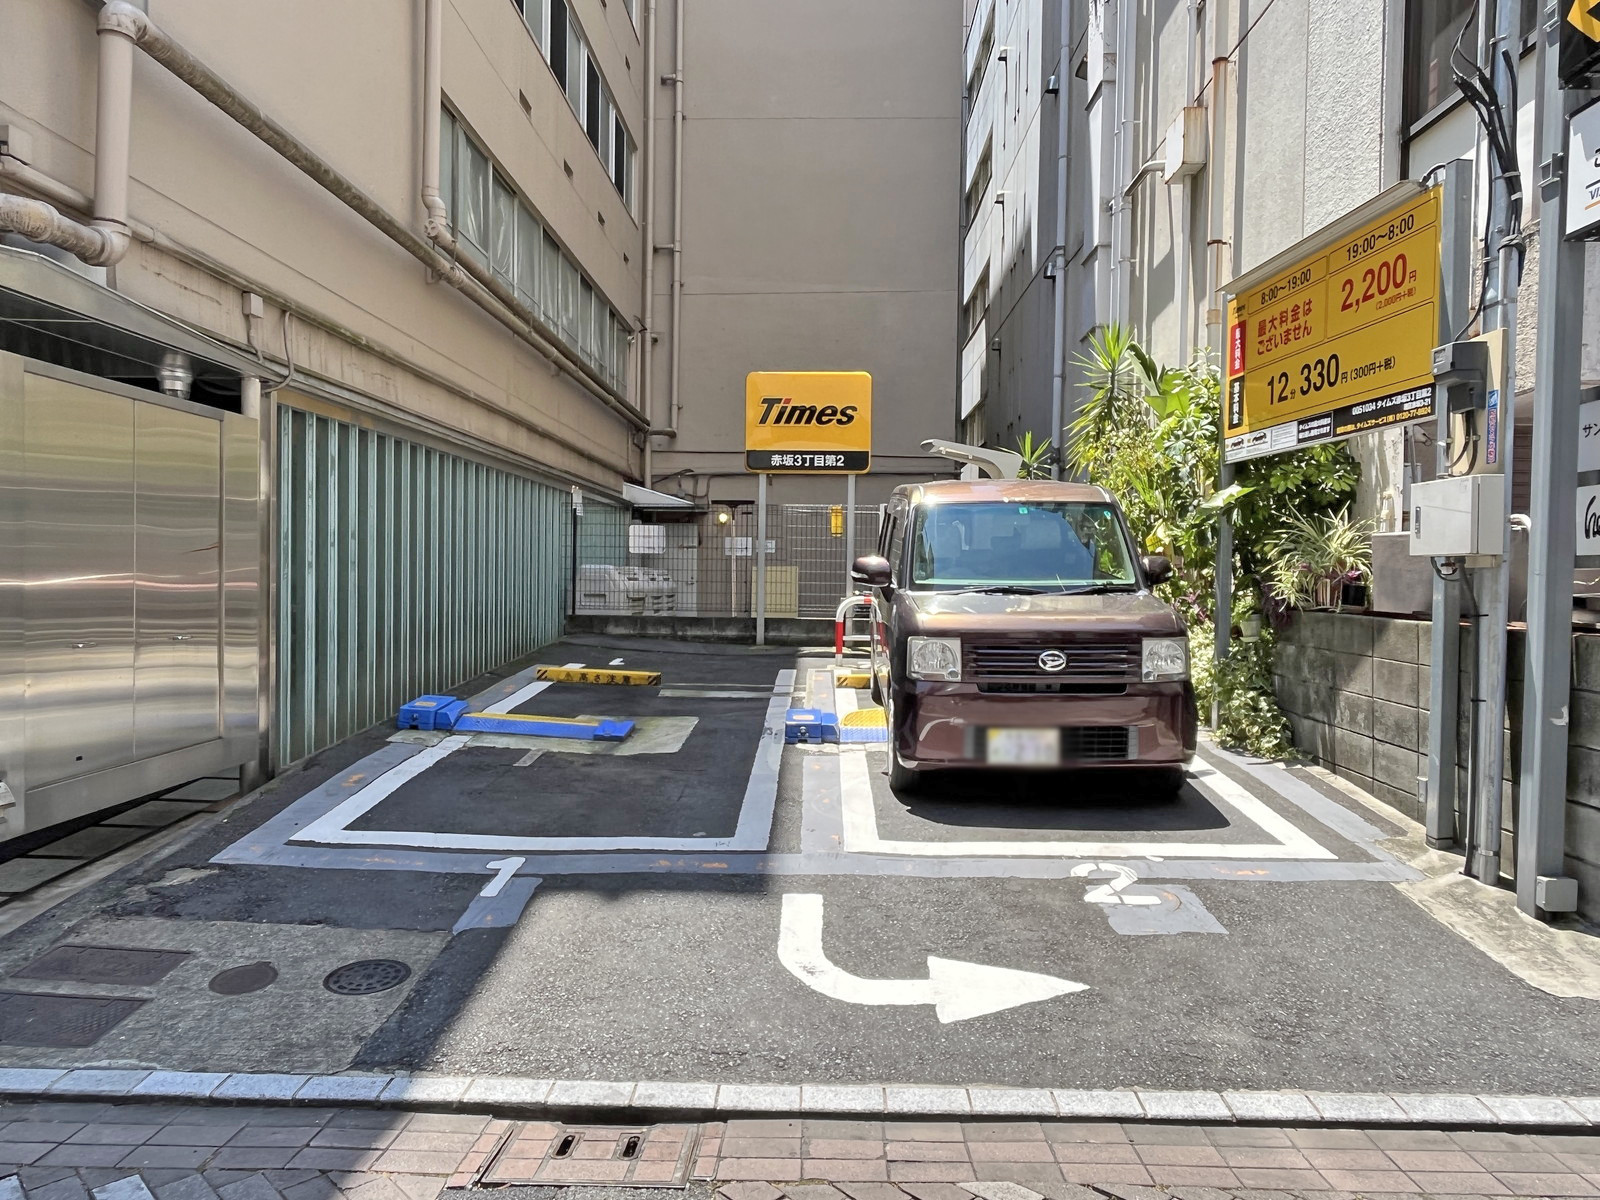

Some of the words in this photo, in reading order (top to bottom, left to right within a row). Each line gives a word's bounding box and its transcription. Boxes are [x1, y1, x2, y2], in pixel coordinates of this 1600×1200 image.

[1257, 297, 1313, 338] 最大料金は
[1256, 319, 1313, 356] ございません
[758, 397, 858, 426] Times
[770, 454, 845, 467] 赤坂3丁目第2
[480, 856, 526, 897] 1
[1070, 862, 1162, 905] 2
